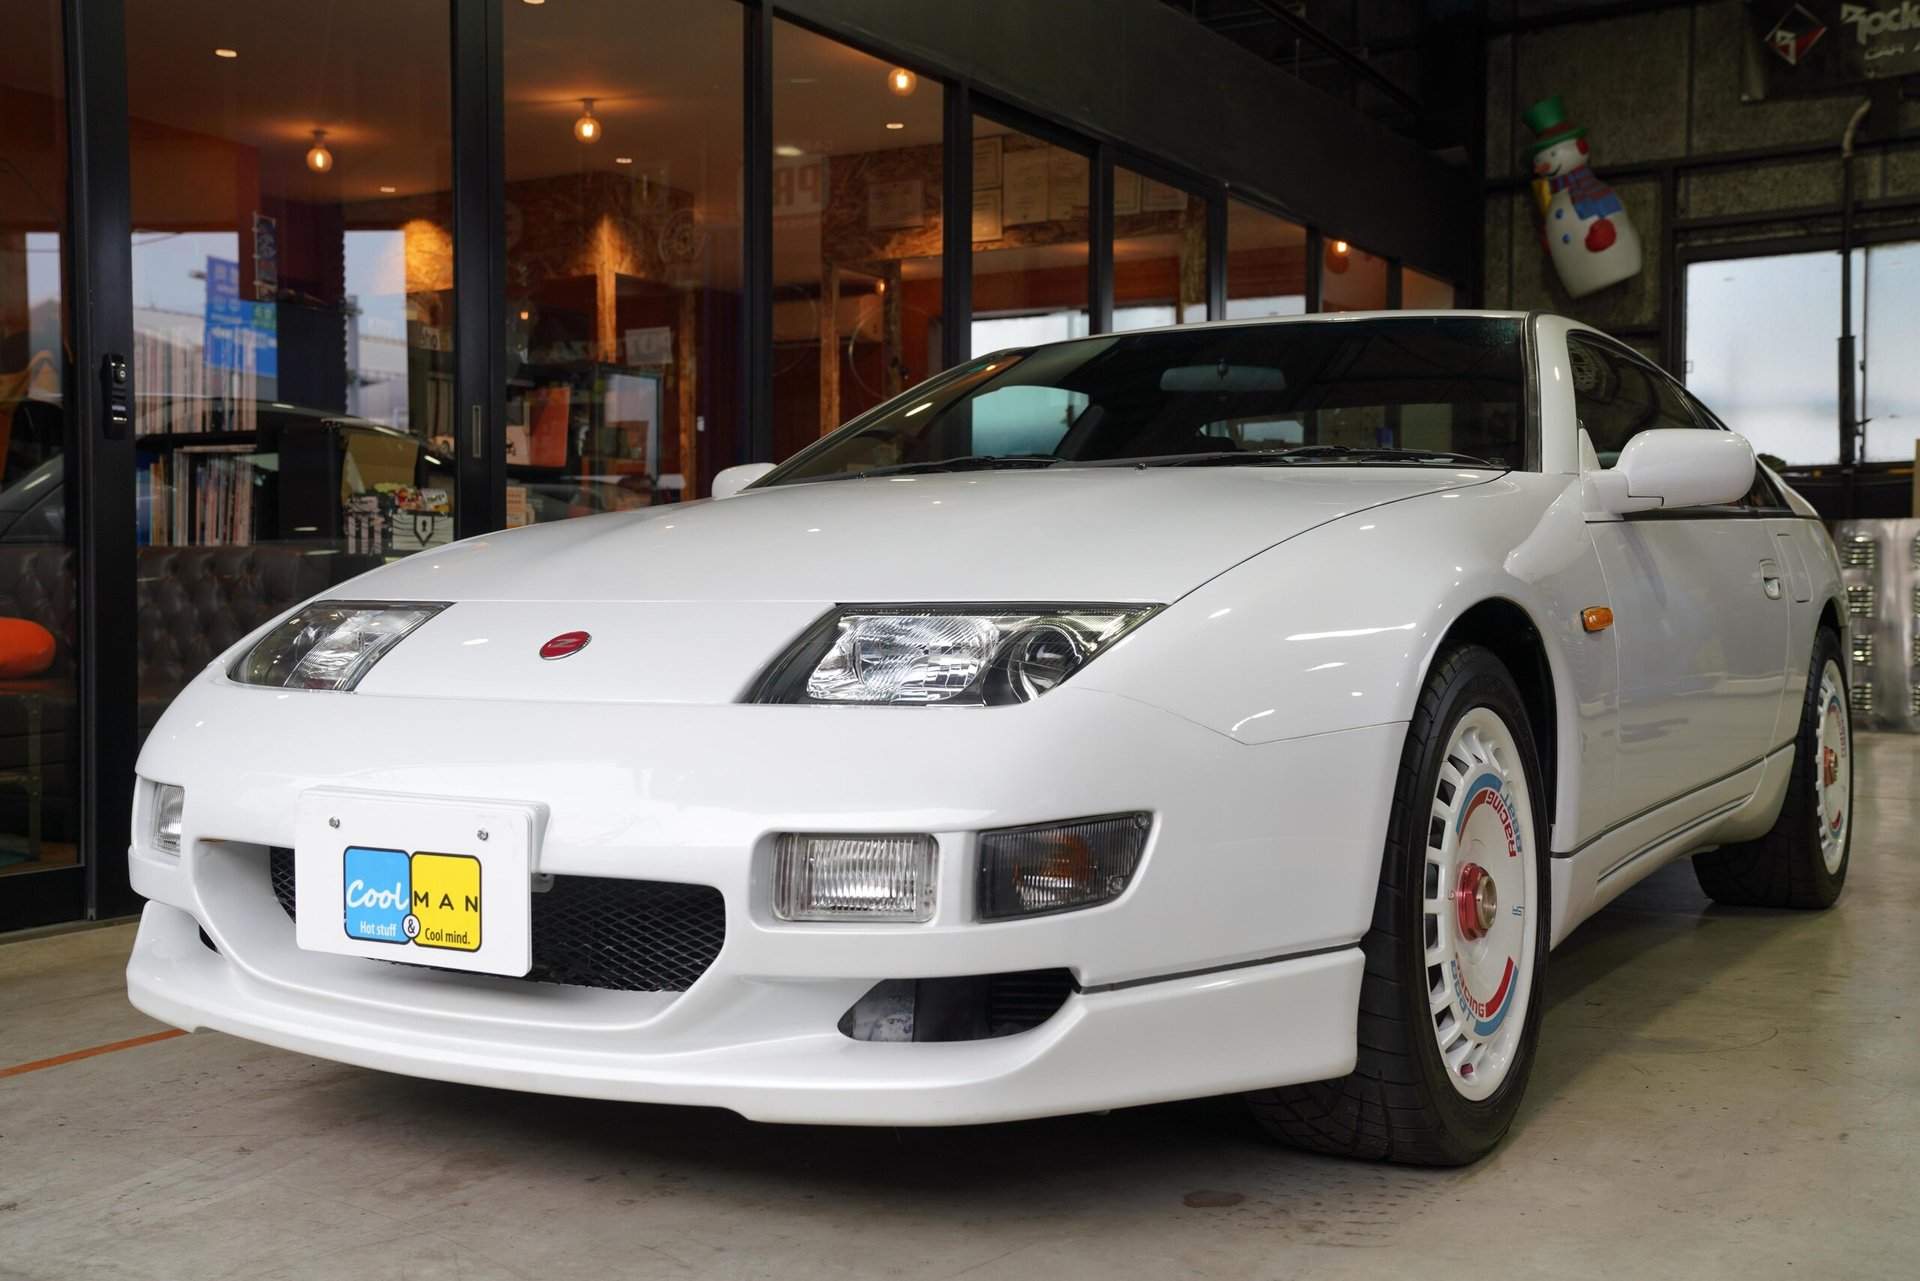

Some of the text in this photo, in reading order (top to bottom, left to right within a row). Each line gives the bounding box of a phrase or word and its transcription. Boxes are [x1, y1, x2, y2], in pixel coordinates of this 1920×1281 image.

[346, 879, 478, 913] Cool MAN
[359, 918, 471, 945] Hot stuff & Cool mind.
